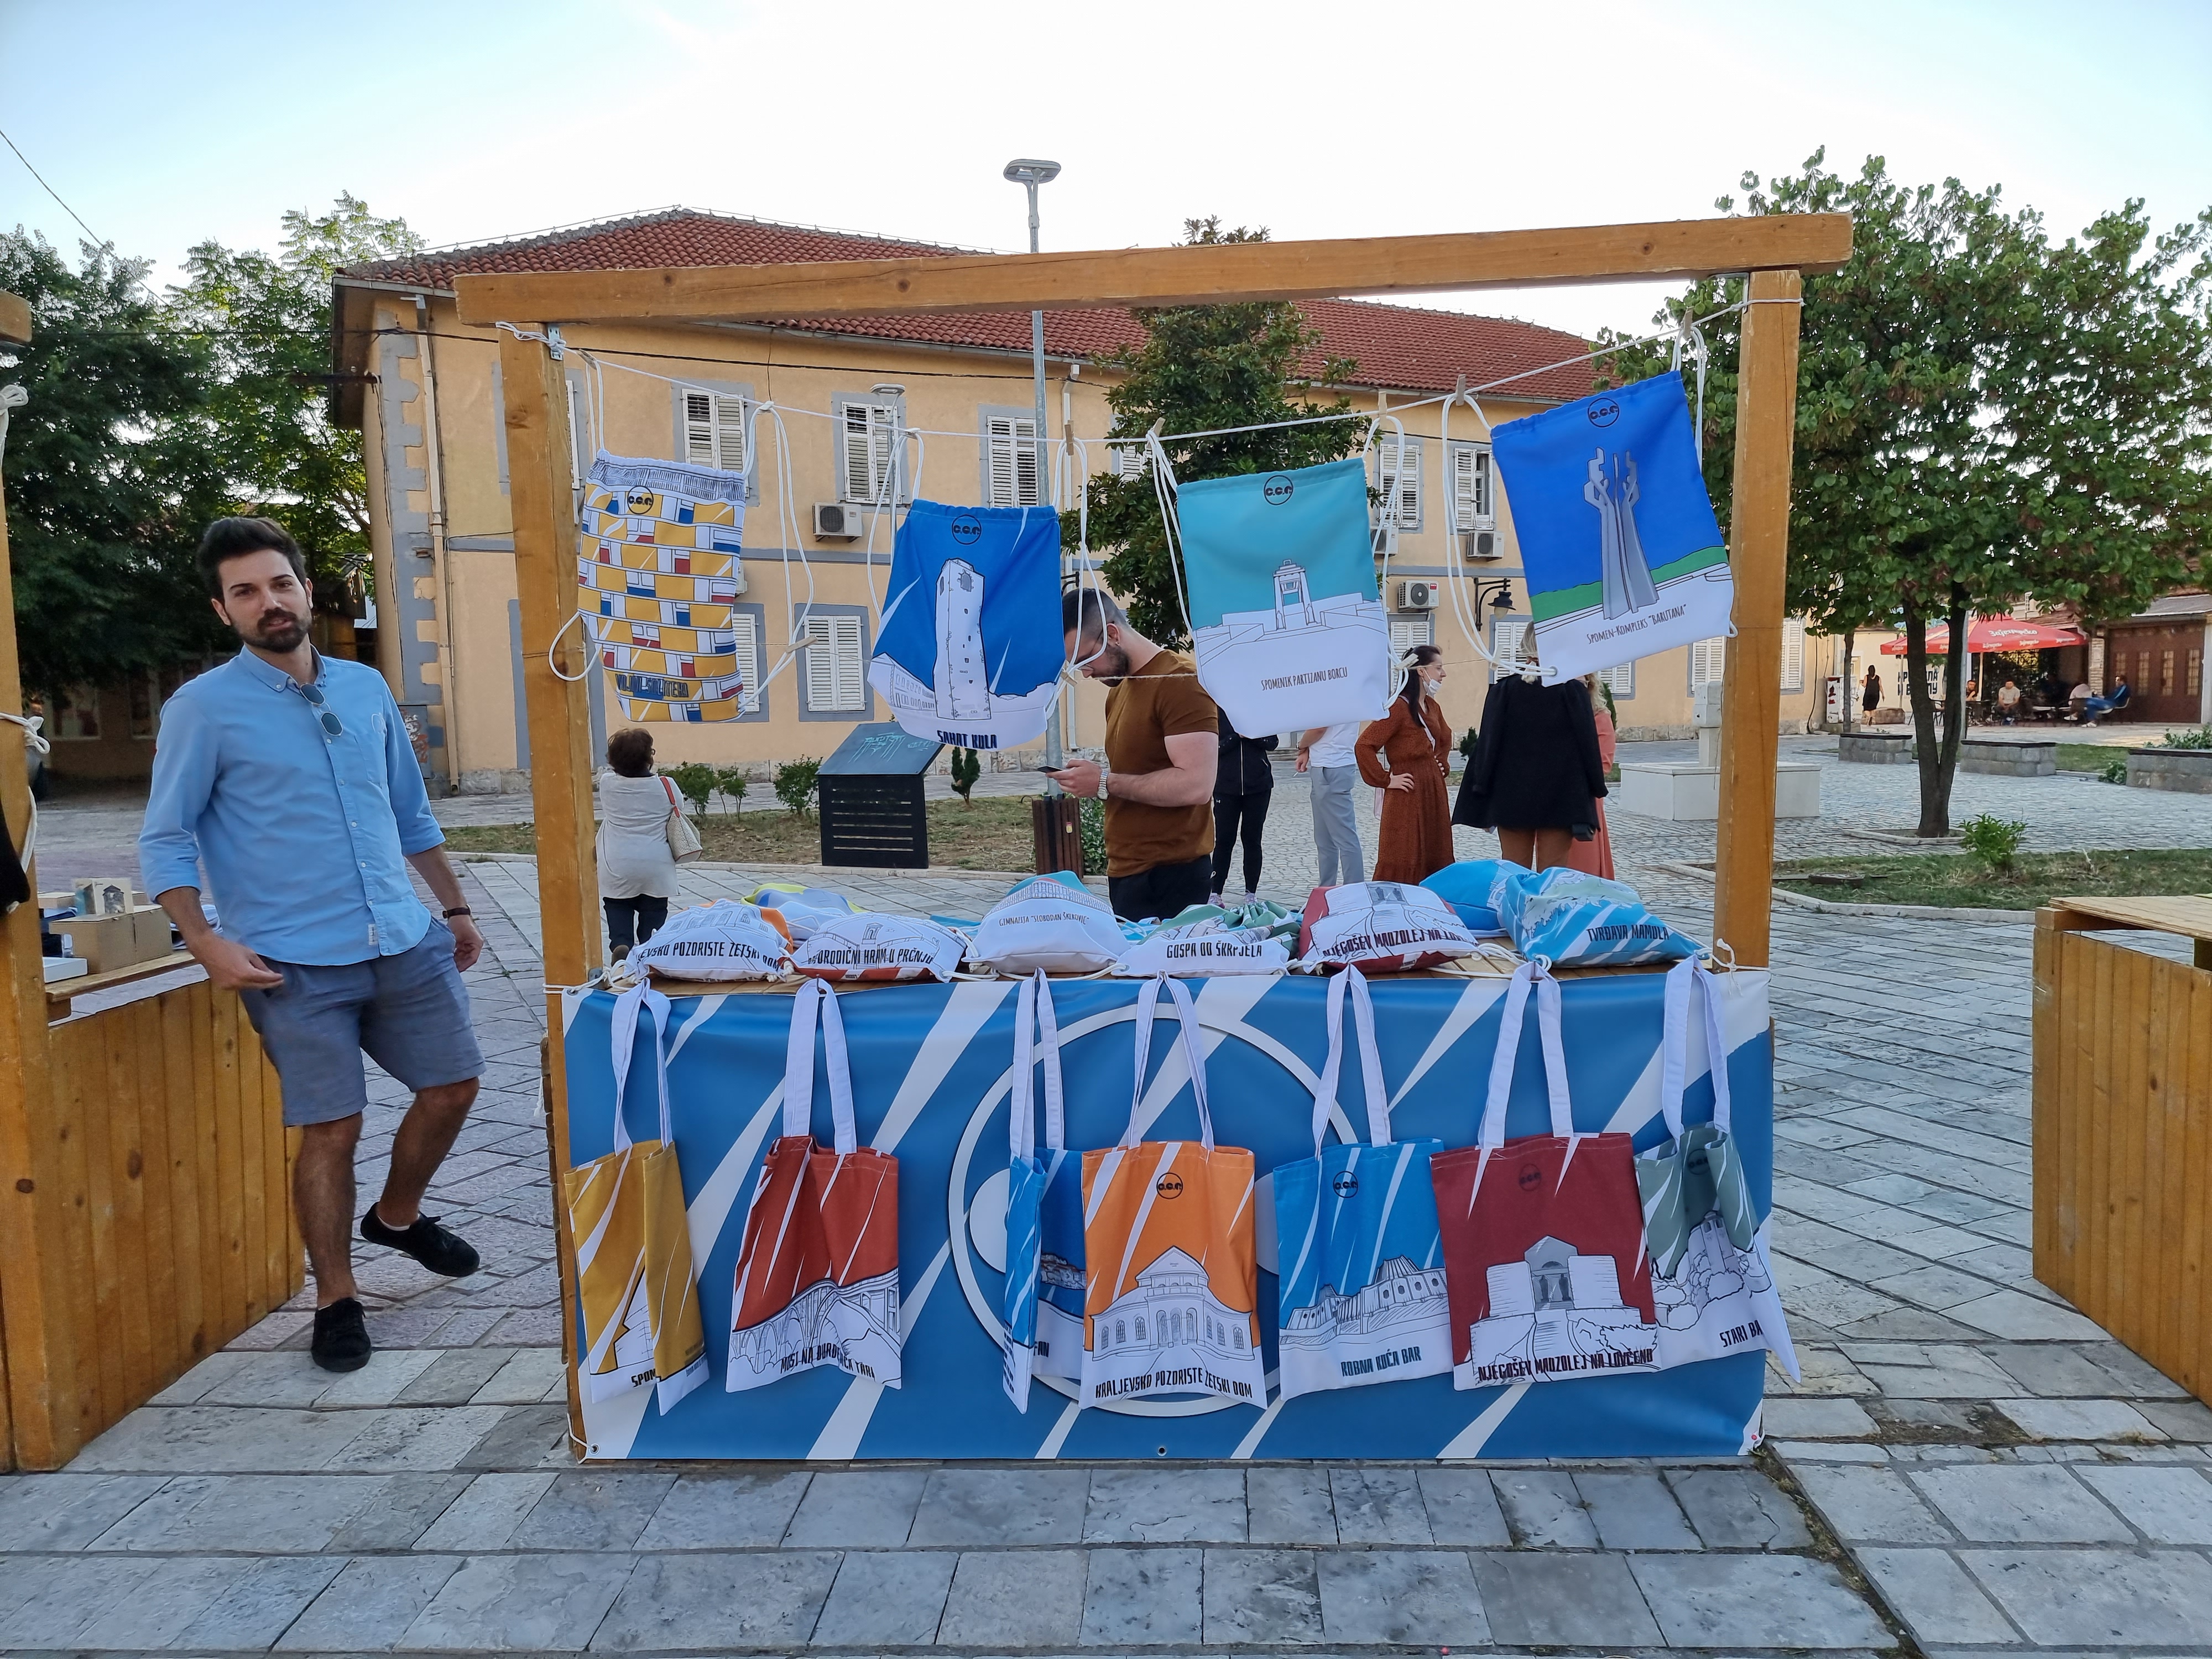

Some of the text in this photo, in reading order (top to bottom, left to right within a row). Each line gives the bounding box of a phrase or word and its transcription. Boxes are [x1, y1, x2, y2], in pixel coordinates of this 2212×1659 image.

[1261, 666, 1348, 691] SPOMENIK PARTIZANU BORCU
[937, 730, 968, 747] SAHAT
[971, 734, 998, 749] KULA
[999, 915, 1029, 927] GIMNAZIJA
[1586, 924, 1670, 942] TVRĐAVA MAMULA
[864, 948, 886, 964] HRAM
[889, 948, 895, 963] U
[897, 947, 934, 964] PRČNJU
[1167, 940, 1262, 958] GOSPA OD ŠKRPJELA
[1322, 935, 1372, 957] NJEGOŠEV
[1373, 929, 1426, 948] MAUZOLEJ
[1427, 929, 1442, 941] NA
[638, 942, 780, 972] EVSKO POZORISTE ZETSKI DOM
[1719, 1325, 1748, 1348] STARI
[801, 1347, 813, 1365] NA
[855, 1360, 875, 1379] TARI
[1340, 1346, 1422, 1377] ROBNA KUĆA BAR
[1478, 1358, 1531, 1381] NJEGOŠEV
[1535, 1355, 1588, 1375] MAUZOLEJ
[1590, 1353, 1604, 1369] NA
[1095, 1367, 1253, 1399] KRALJEVSKO POZORISTE ZETSKI DOM
